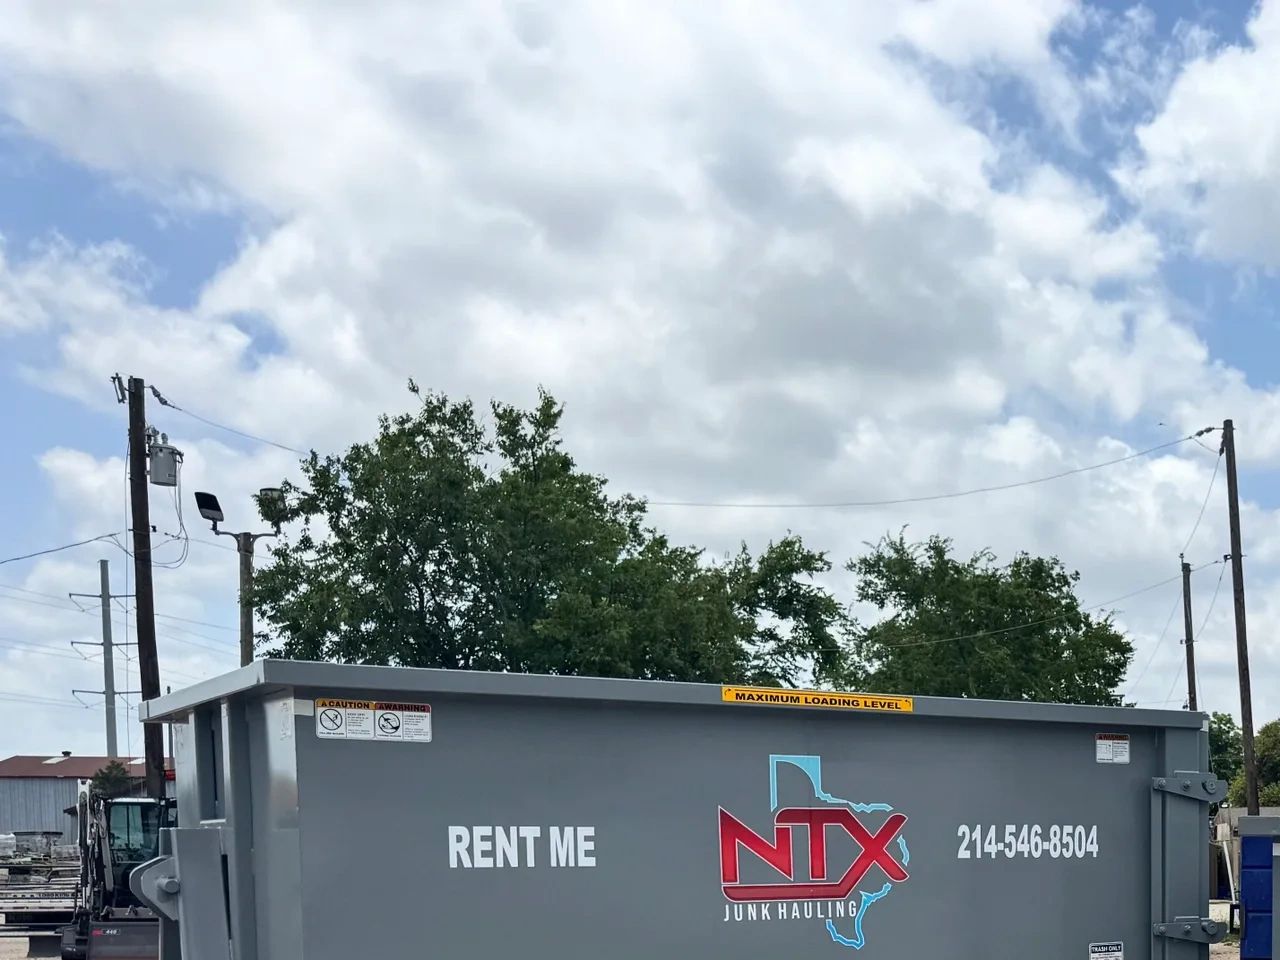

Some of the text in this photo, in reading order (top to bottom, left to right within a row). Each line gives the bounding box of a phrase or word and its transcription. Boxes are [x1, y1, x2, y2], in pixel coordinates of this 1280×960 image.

[328, 700, 370, 709] CAUTION
[383, 703, 426, 712] WARNING
[735, 692, 901, 710] MAXIMUM LOADING LEVEL
[448, 825, 596, 868] RENT ME
[957, 824, 1099, 859] 214-546-8504
[718, 805, 910, 902] NTX
[724, 900, 857, 922] JUNK HAULING
[1108, 944, 1121, 952] ONLY
